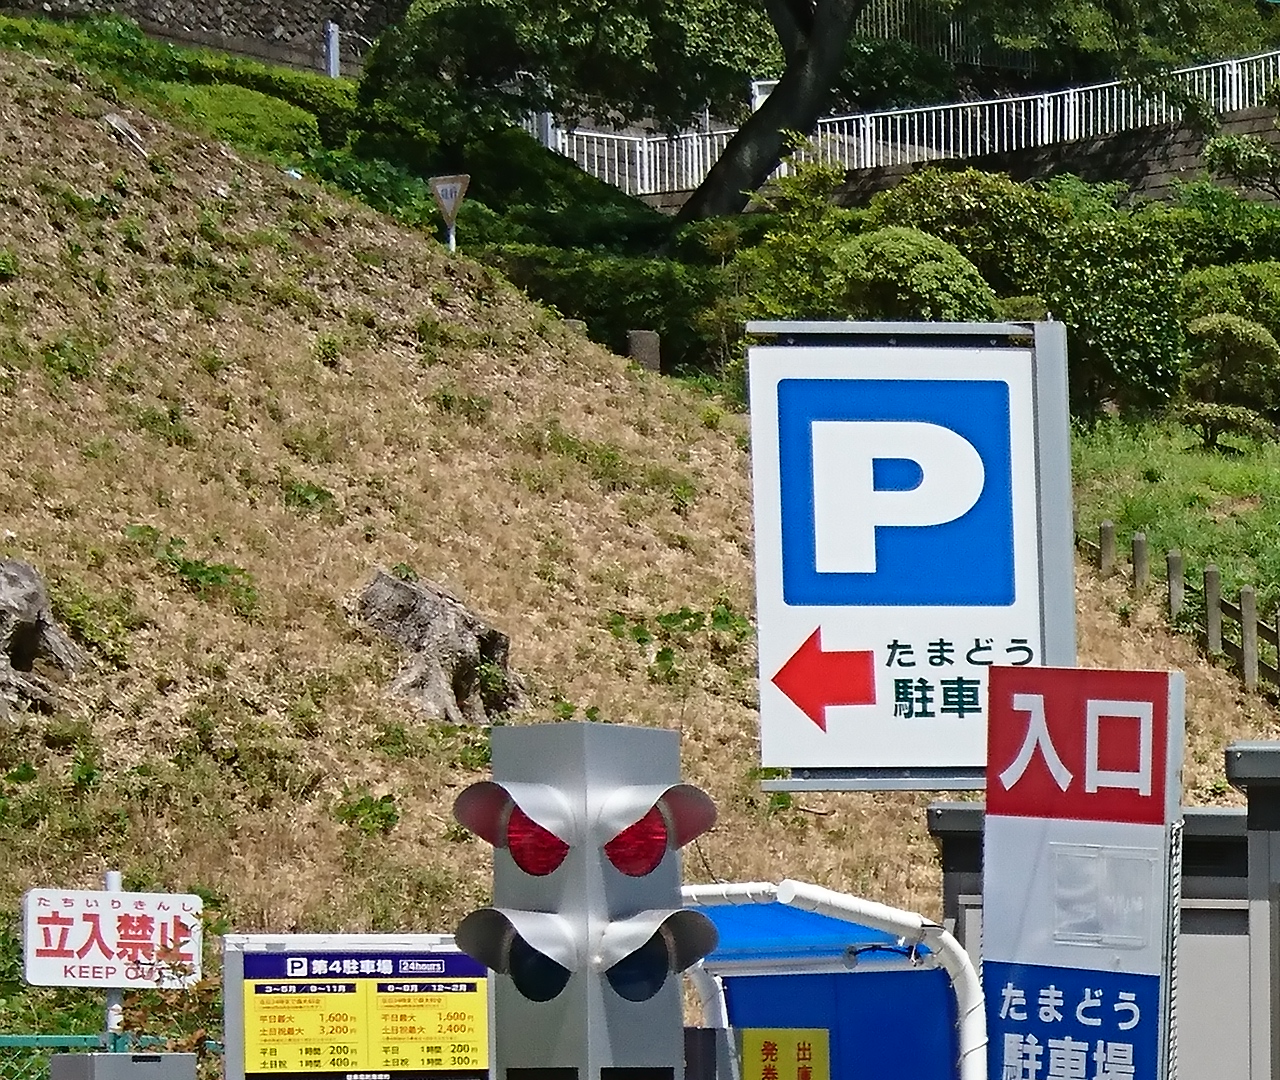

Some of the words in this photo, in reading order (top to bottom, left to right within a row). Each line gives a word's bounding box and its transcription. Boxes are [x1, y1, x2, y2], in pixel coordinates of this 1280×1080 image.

[811, 421, 985, 573] P
[885, 638, 1035, 667] たまどう
[893, 677, 982, 719] 駐車
[999, 694, 1154, 796] 入口
[37, 897, 193, 912] たちいりきんし
[35, 910, 193, 962] 立入禁止
[63, 965, 117, 979] KEEP
[312, 959, 393, 975] 第4駐車場
[999, 982, 1141, 1031] たまどう
